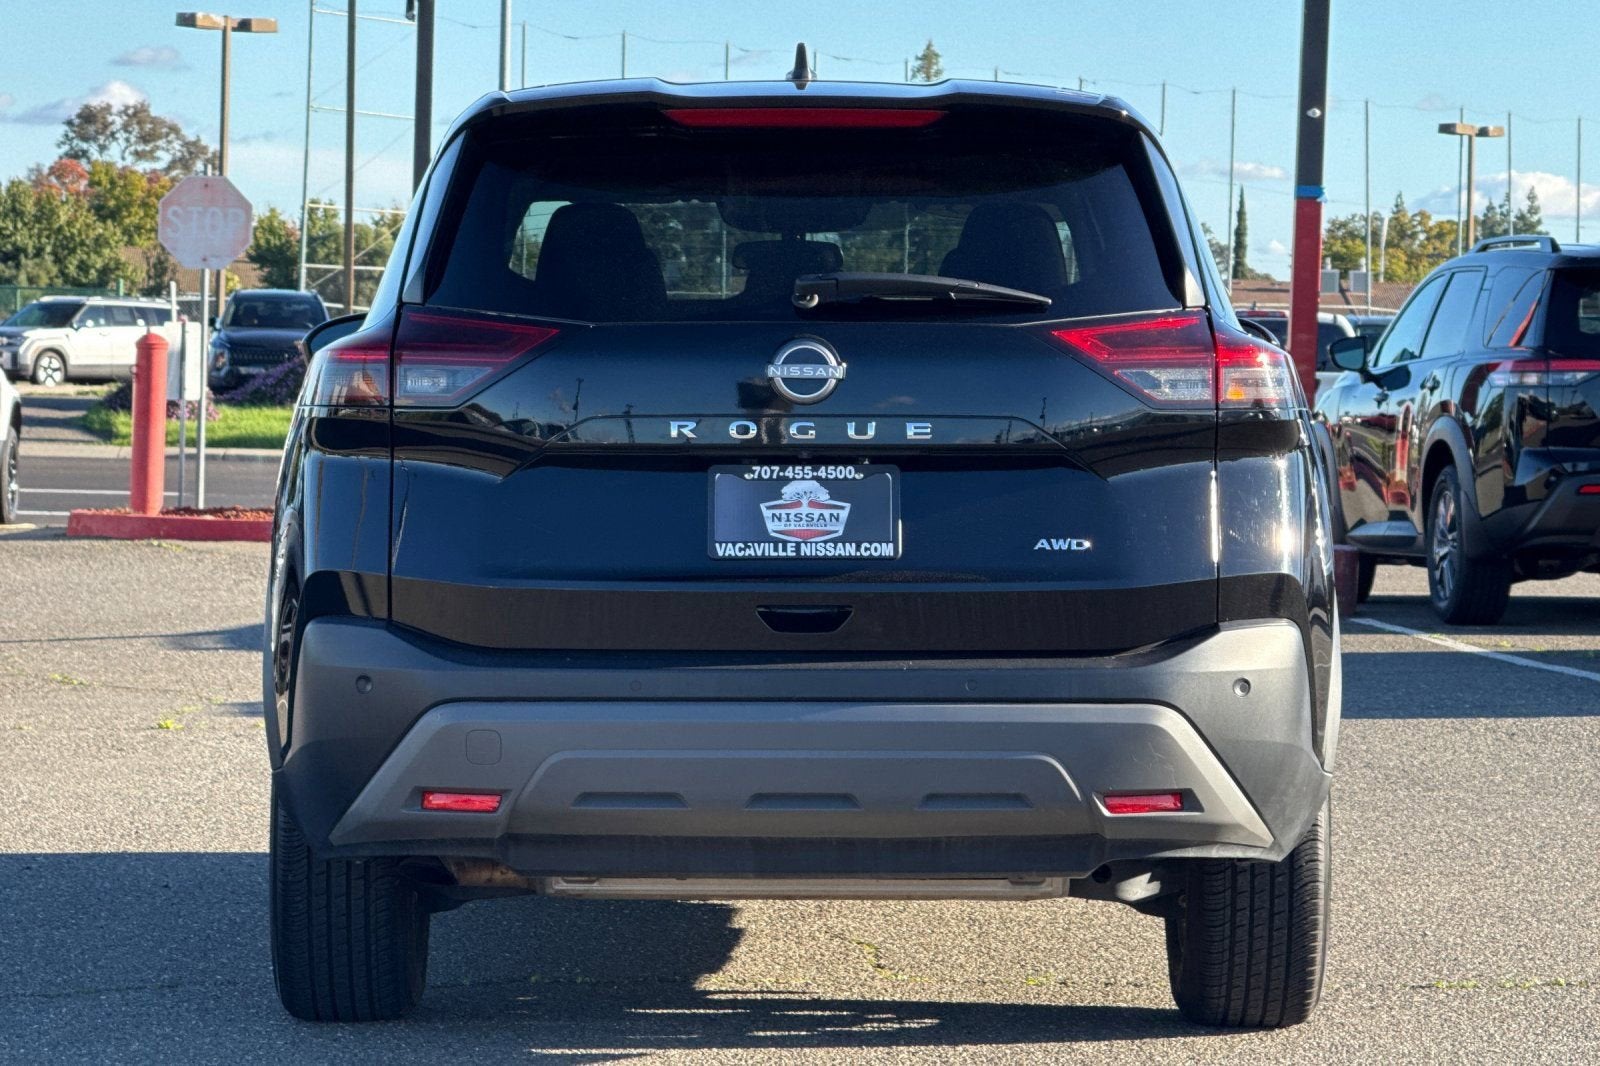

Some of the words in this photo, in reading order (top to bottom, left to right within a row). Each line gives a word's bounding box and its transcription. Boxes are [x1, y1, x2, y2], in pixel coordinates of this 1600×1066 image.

[166, 206, 246, 239] STOP
[769, 366, 840, 377] NISSAN
[670, 420, 933, 440] ROGUE
[752, 466, 855, 479] 707-455-4500
[771, 512, 840, 522] NISSAN
[715, 543, 796, 556] VACAVILLE
[800, 543, 894, 557] NISSAN.COM
[1033, 538, 1092, 550] AWD
